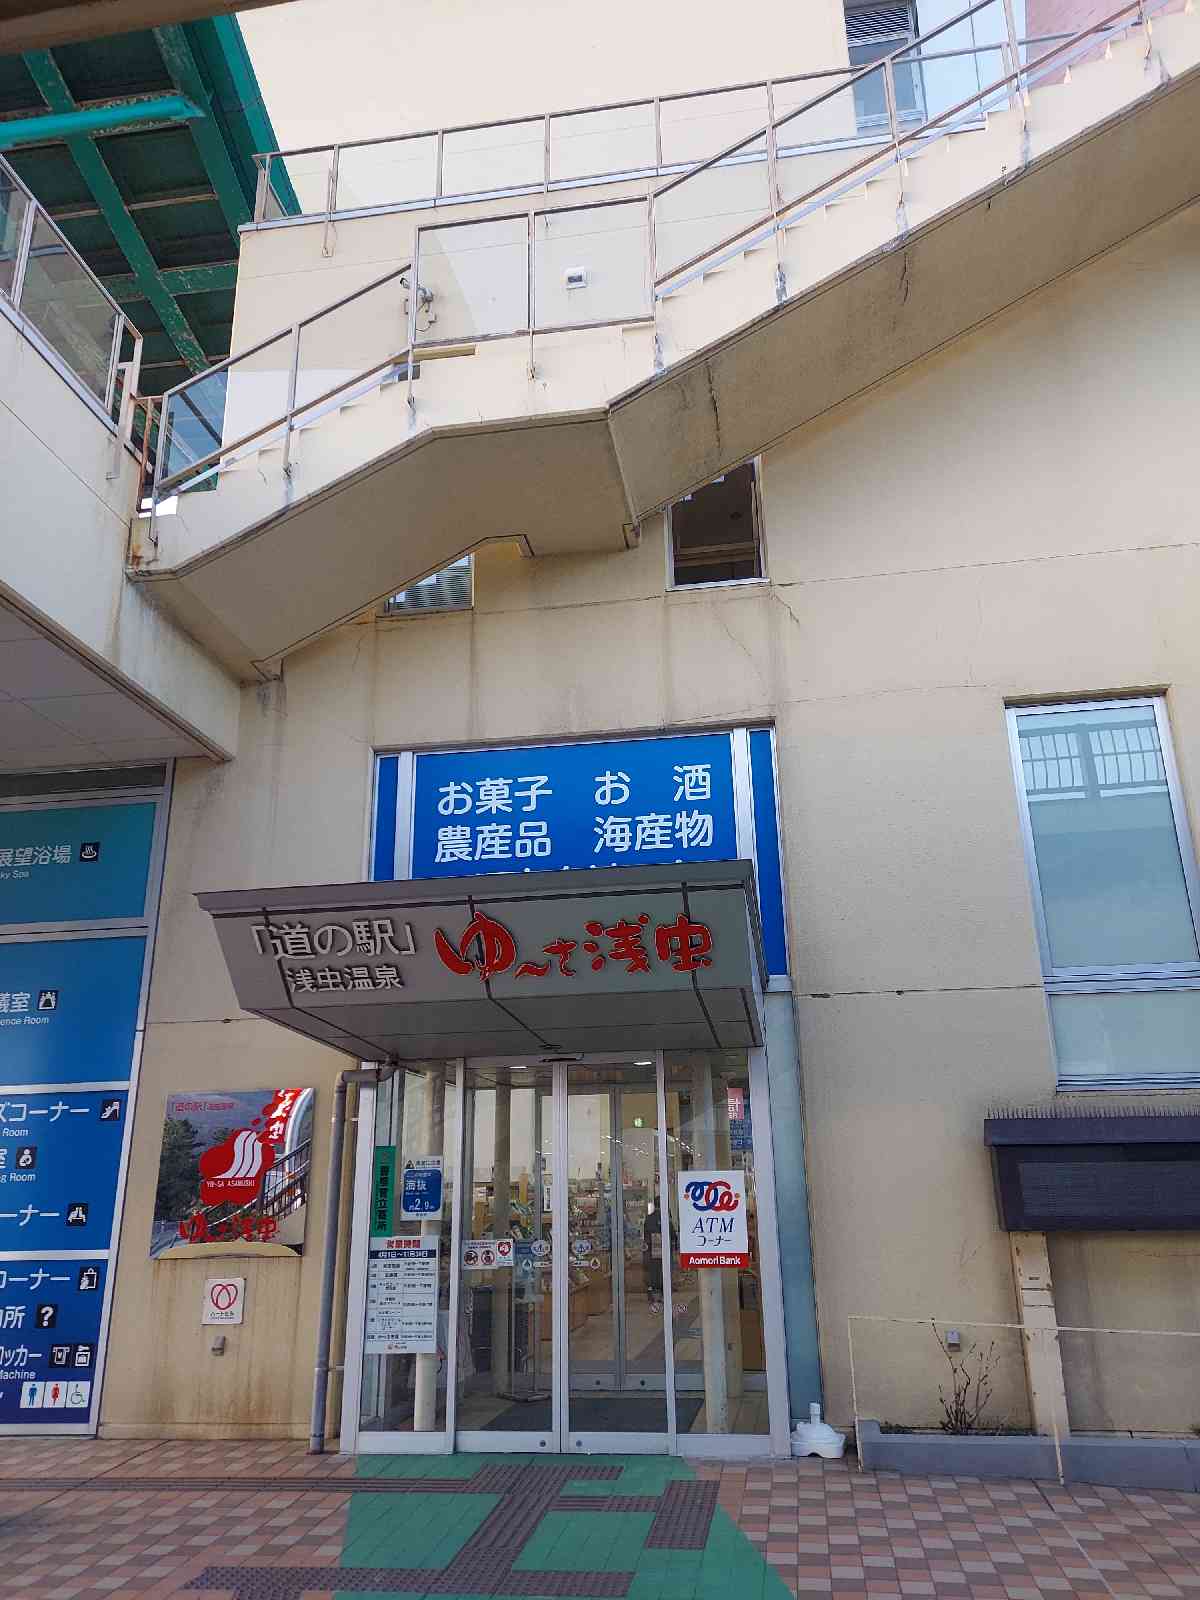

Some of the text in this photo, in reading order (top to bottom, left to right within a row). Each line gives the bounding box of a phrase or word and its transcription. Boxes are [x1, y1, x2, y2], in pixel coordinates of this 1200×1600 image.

[437, 763, 711, 816] お菓子 お 酒
[434, 810, 714, 863] 農産品 海産物
[250, 919, 416, 961] 「道の駅」
[287, 963, 403, 993] 浅虫温泉
[24, 1016, 49, 1025] Room
[2, 1127, 29, 1137] Room
[10, 1172, 36, 1182] Room
[692, 1217, 735, 1234] ATM
[696, 1235, 731, 1247] コーナー
[689, 1256, 741, 1265] Aomori Bank
[0, 1305, 27, 1329] 所
